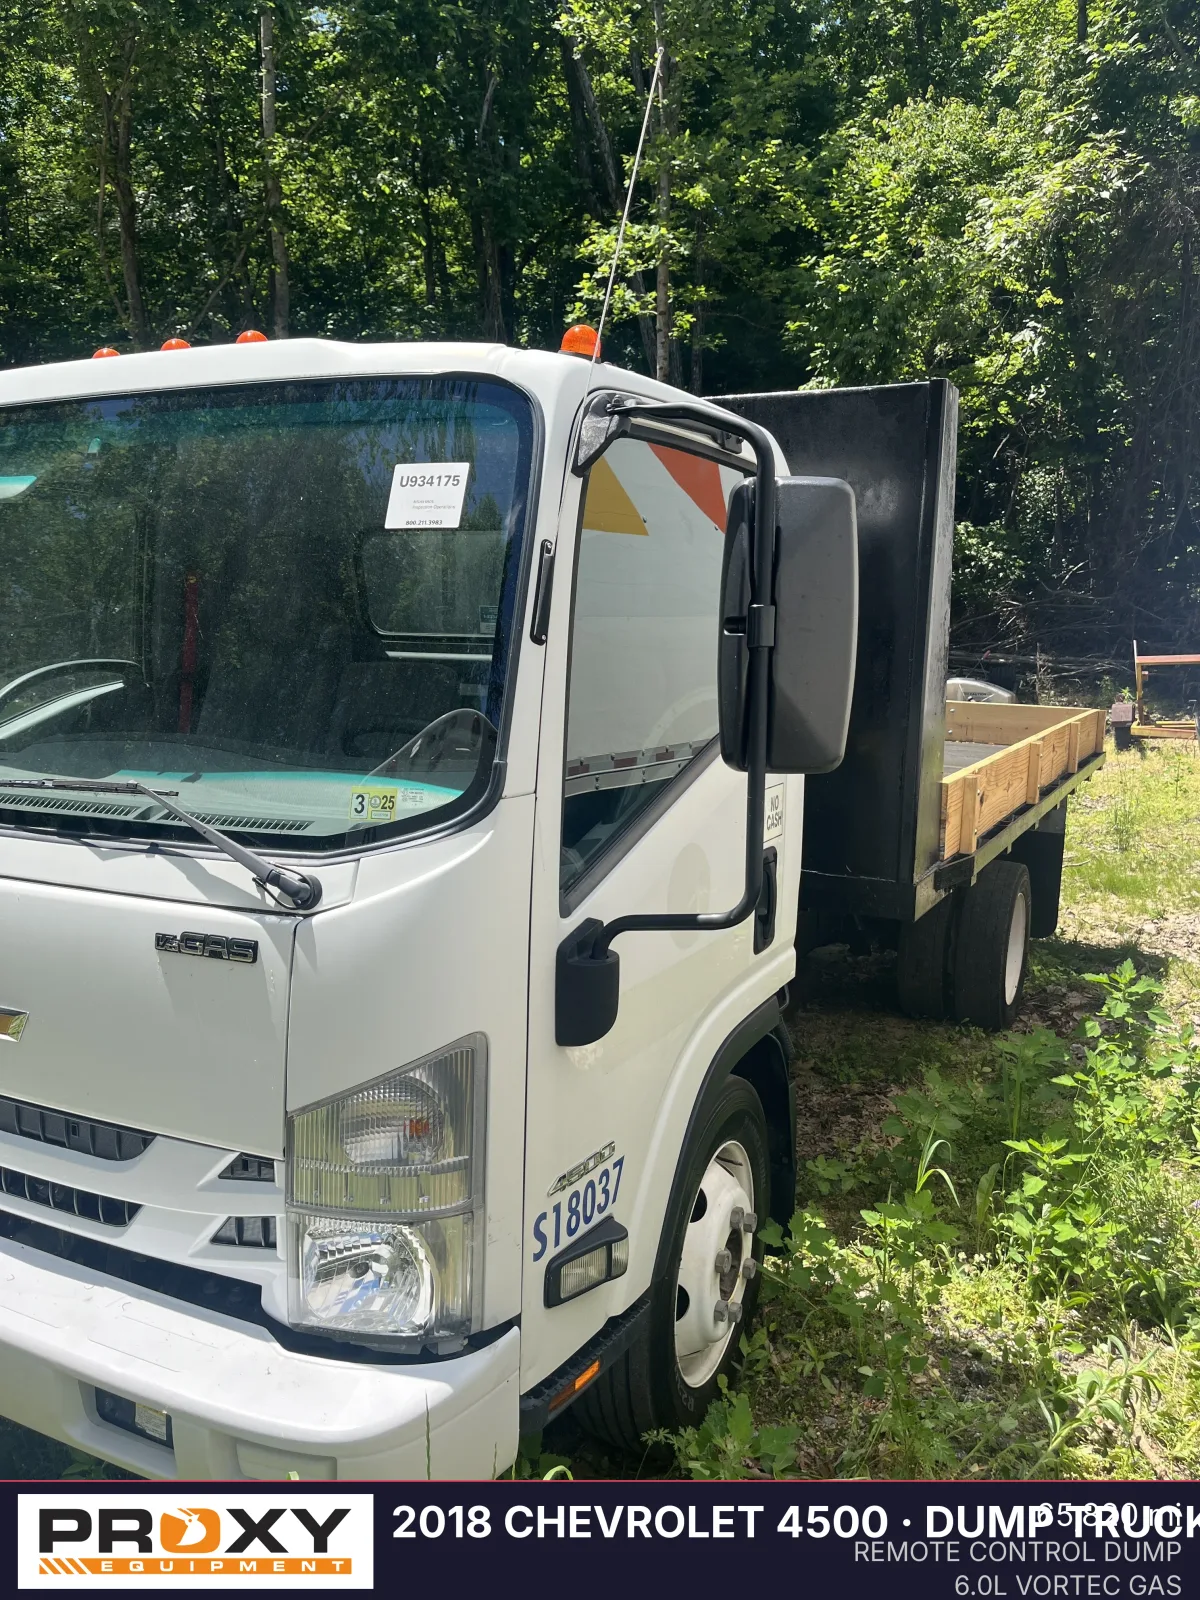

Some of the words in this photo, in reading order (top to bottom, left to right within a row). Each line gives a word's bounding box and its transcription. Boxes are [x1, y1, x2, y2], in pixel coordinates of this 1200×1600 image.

[400, 475, 460, 487] U934175
[354, 794, 365, 814] 3
[380, 795, 395, 810] 25
[771, 795, 780, 812] NO
[767, 811, 783, 831] CASH
[547, 1140, 616, 1197] 4500
[532, 1155, 625, 1263] S18037
